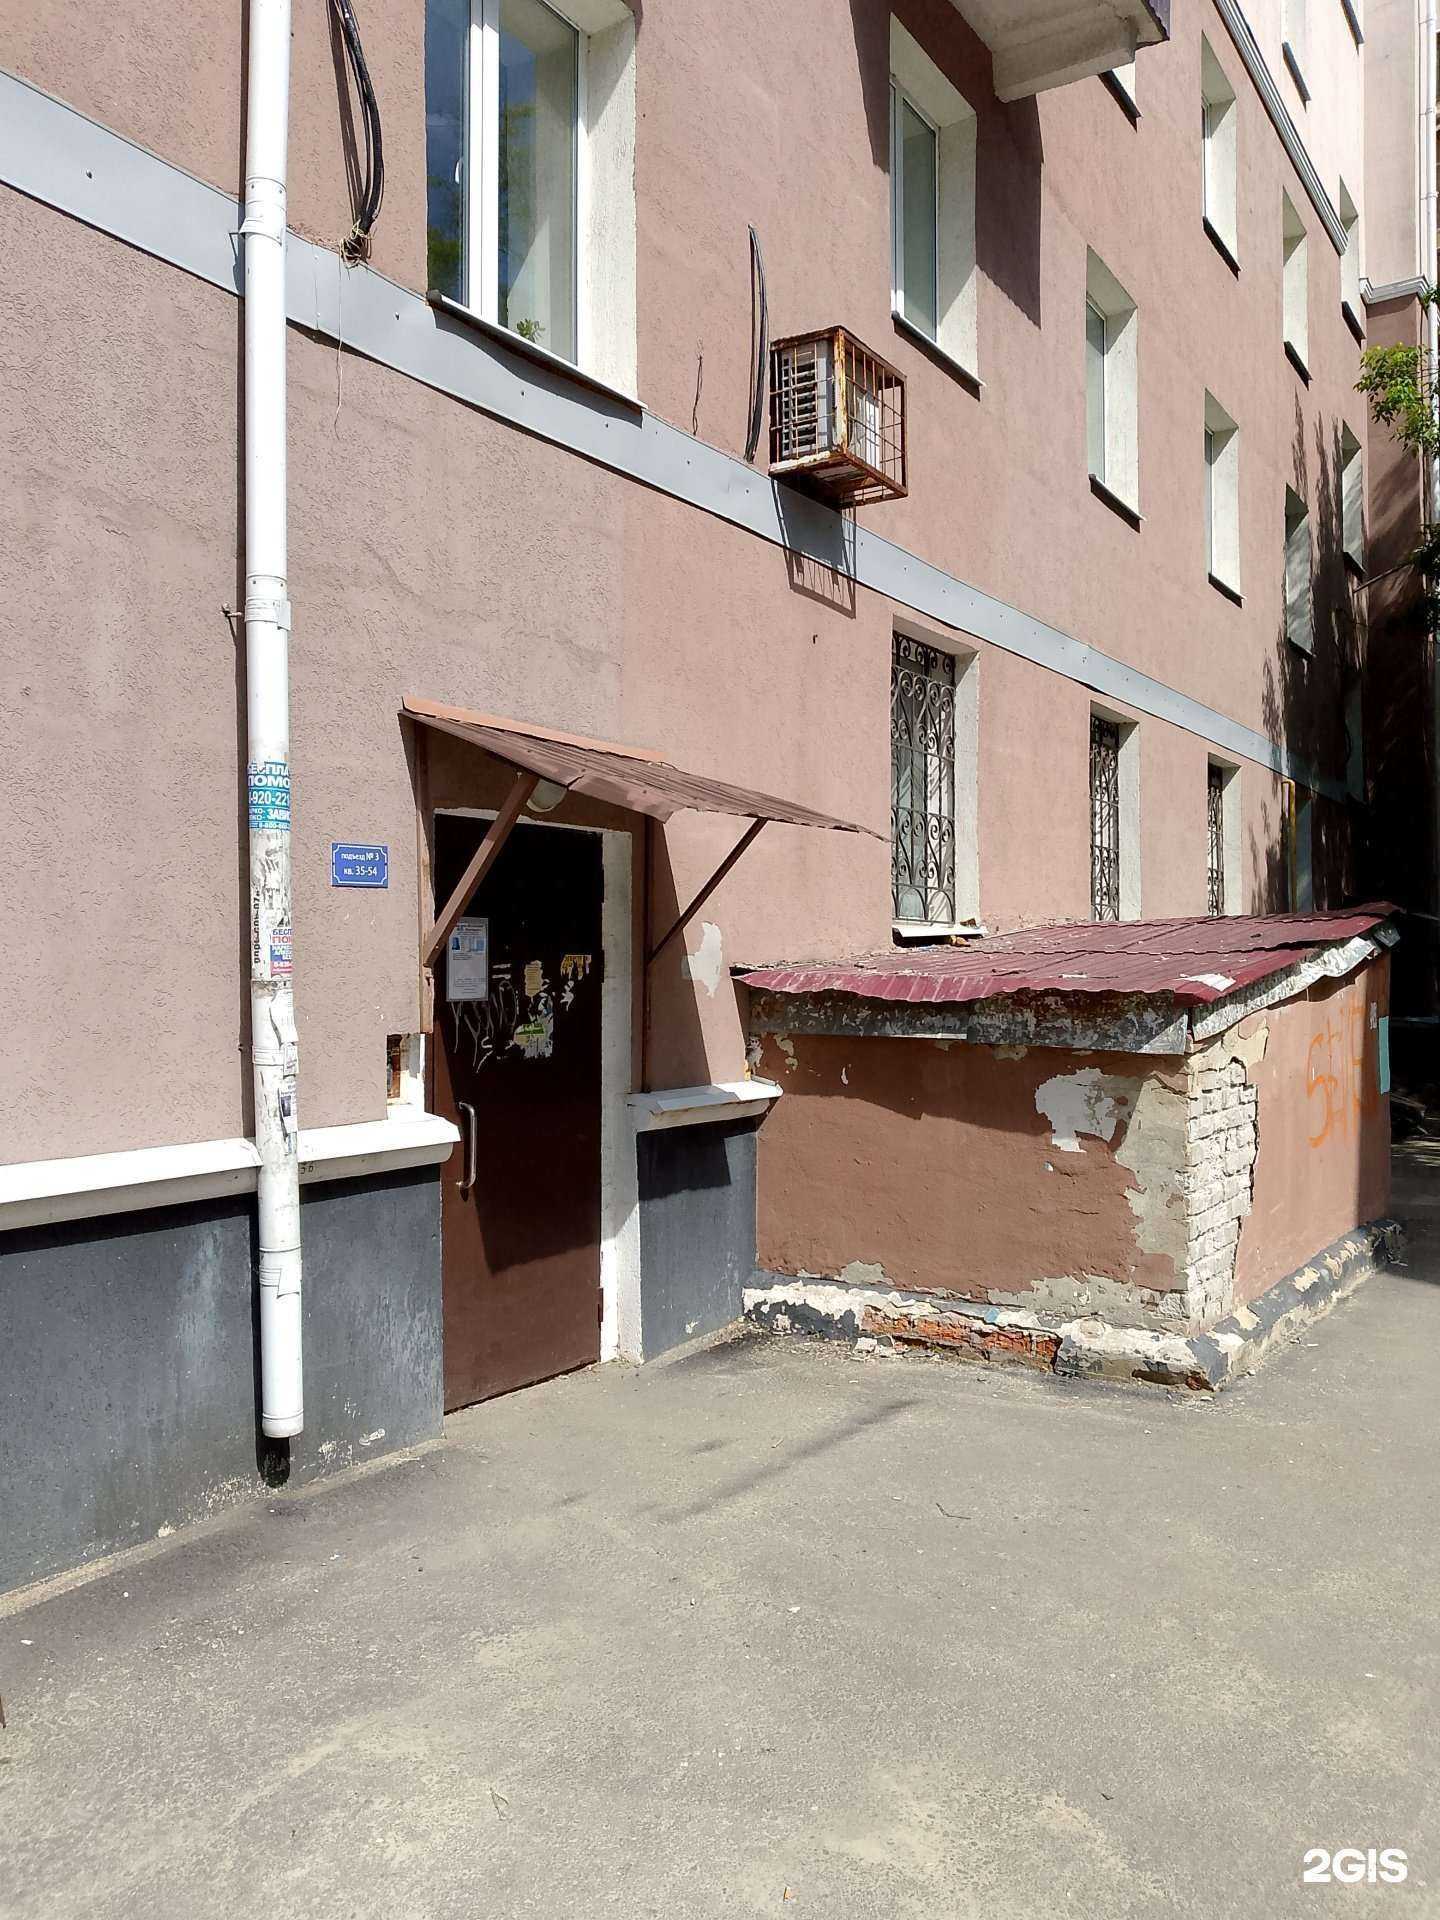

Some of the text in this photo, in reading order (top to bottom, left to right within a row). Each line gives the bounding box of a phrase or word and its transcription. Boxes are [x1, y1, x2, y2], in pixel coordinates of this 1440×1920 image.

[340, 853, 365, 862] подъезд
[375, 852, 380, 861] 3
[343, 865, 378, 876] кв. 35-54
